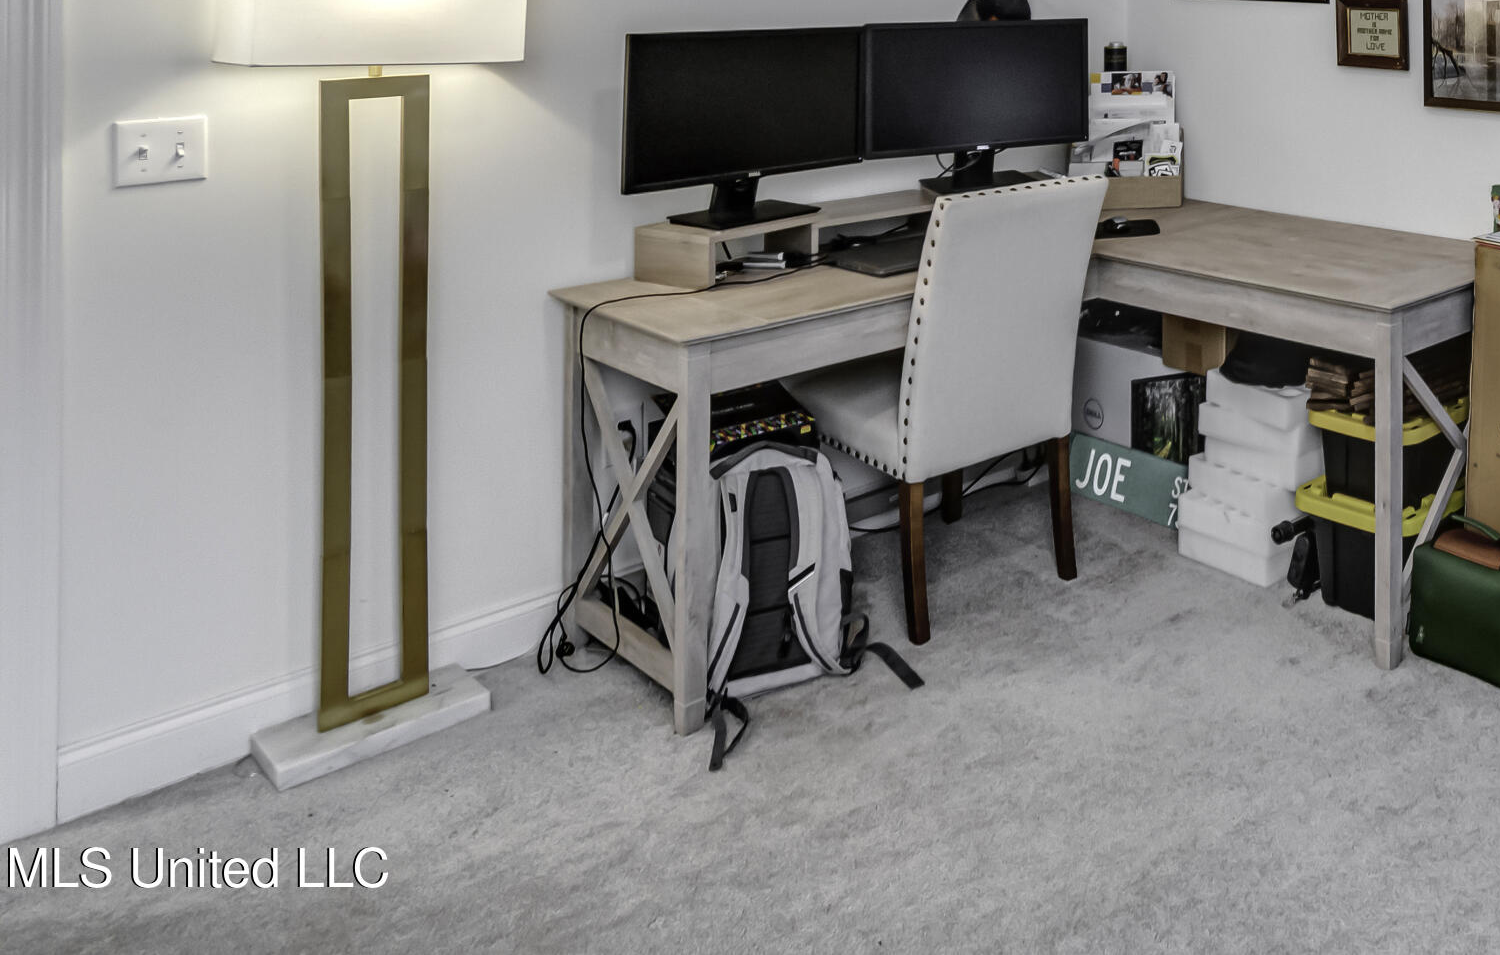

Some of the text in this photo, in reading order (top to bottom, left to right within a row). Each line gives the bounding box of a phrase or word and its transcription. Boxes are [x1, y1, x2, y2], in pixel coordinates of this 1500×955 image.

[1360, 12, 1389, 21] MOTHER
[1365, 42, 1386, 51] LOVE
[1075, 448, 1131, 503] JOE
